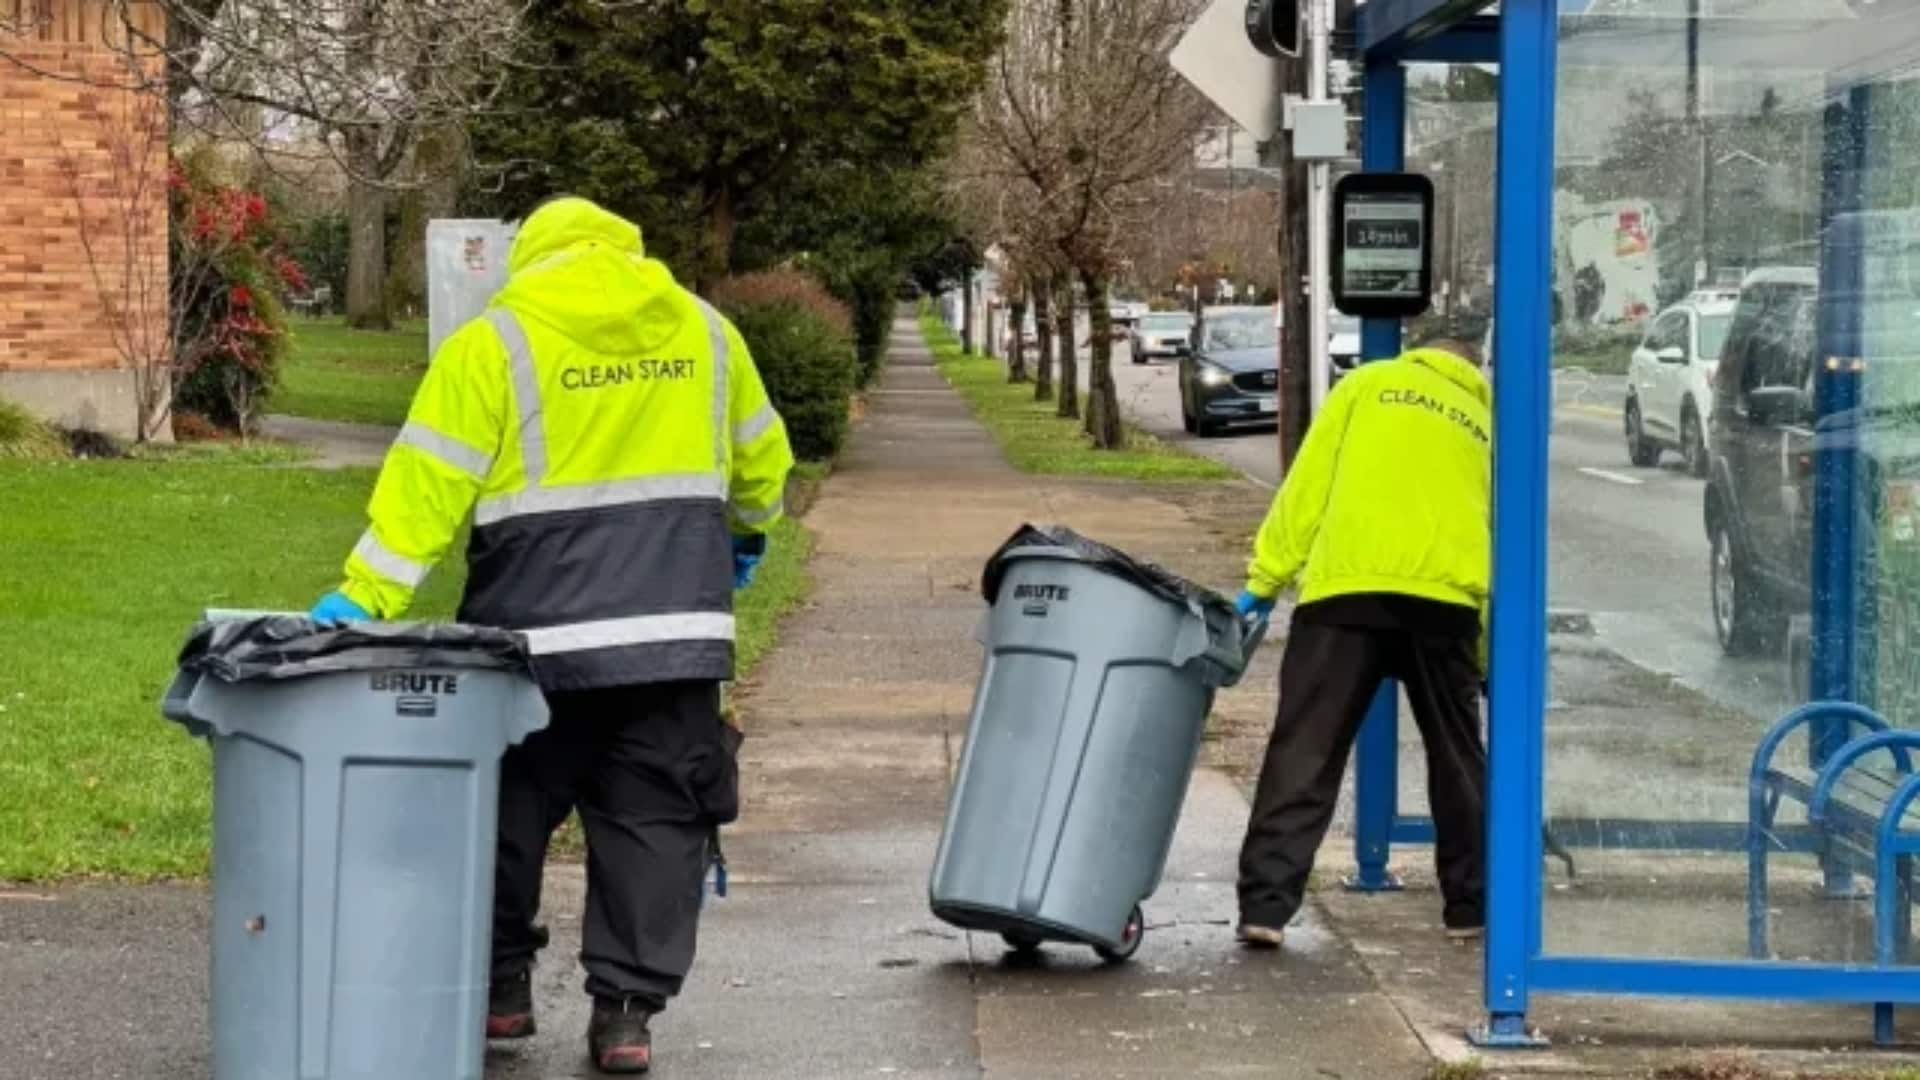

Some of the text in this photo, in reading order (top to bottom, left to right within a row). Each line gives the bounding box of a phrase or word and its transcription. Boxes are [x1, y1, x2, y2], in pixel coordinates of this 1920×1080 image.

[560, 359, 696, 390] CLEAN START
[1378, 389, 1444, 415] CLEAN
[1013, 584, 1070, 601] BRUTE
[370, 673, 457, 694] BRUTE
